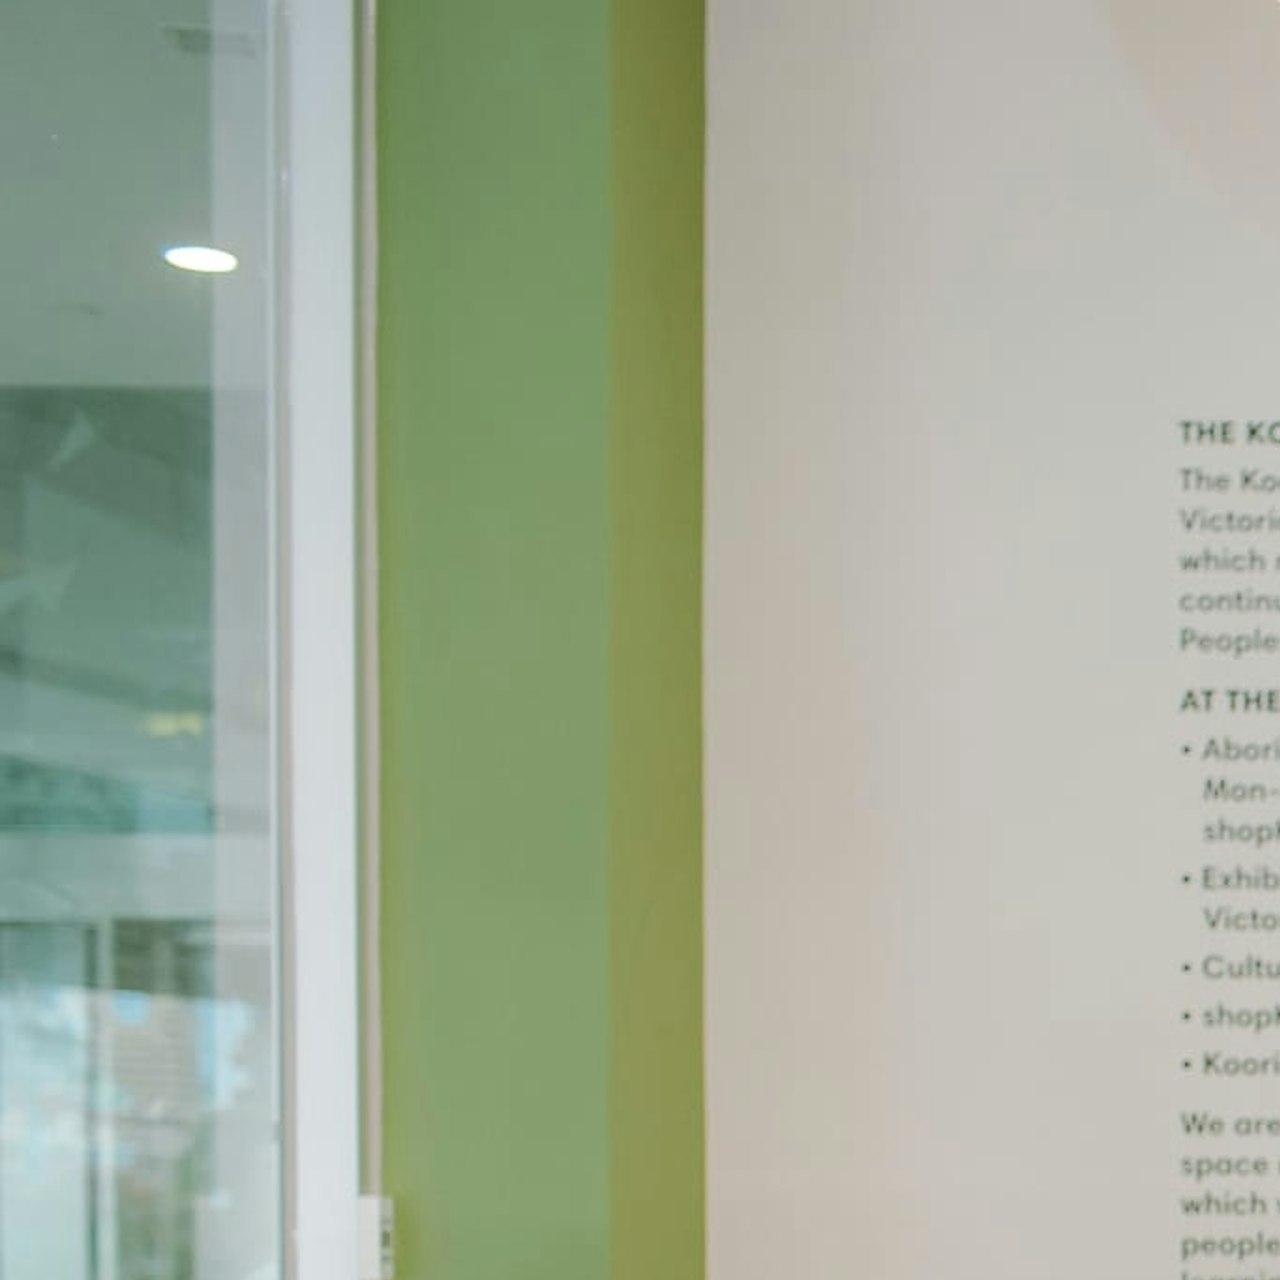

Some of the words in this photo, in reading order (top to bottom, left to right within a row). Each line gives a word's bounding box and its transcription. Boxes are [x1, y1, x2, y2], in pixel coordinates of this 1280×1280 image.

[1178, 421, 1234, 444] THE
[1181, 468, 1229, 491] The
[1180, 549, 1265, 571] which
[1181, 690, 1215, 712] AT
[1226, 690, 1280, 712] THE
[1181, 1113, 1224, 1136] We
[1182, 1157, 1267, 1183] space
[1181, 1192, 1266, 1214] which
[1182, 1232, 1280, 1260] people
